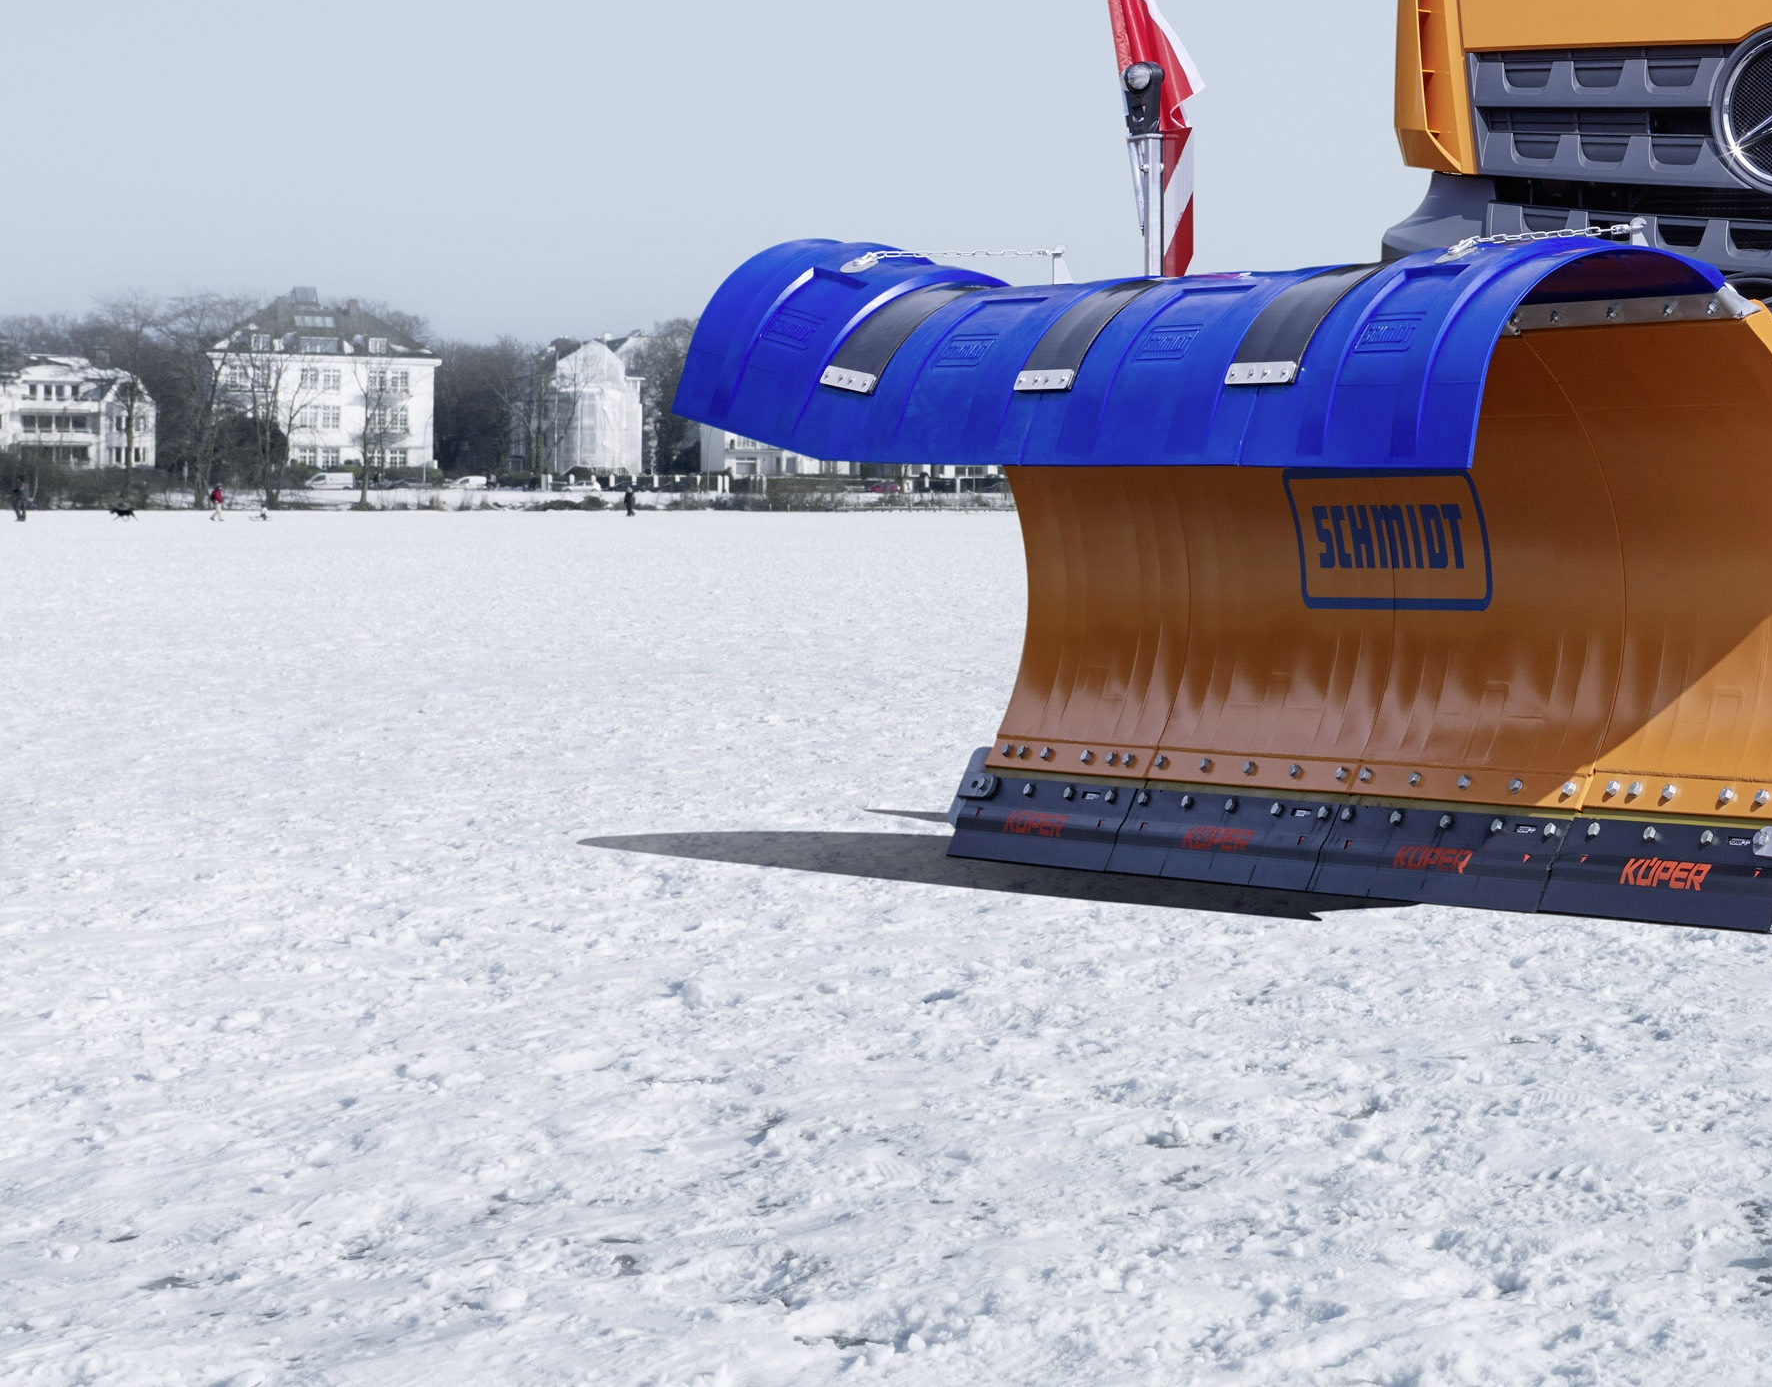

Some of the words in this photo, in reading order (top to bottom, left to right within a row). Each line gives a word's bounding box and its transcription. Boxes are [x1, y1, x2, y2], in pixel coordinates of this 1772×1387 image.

[1312, 504, 1464, 569] SCHMIDT
[1182, 825, 1255, 853] KÜPER
[1393, 843, 1473, 875] KÜPER
[1619, 856, 1712, 891] KÜPER
